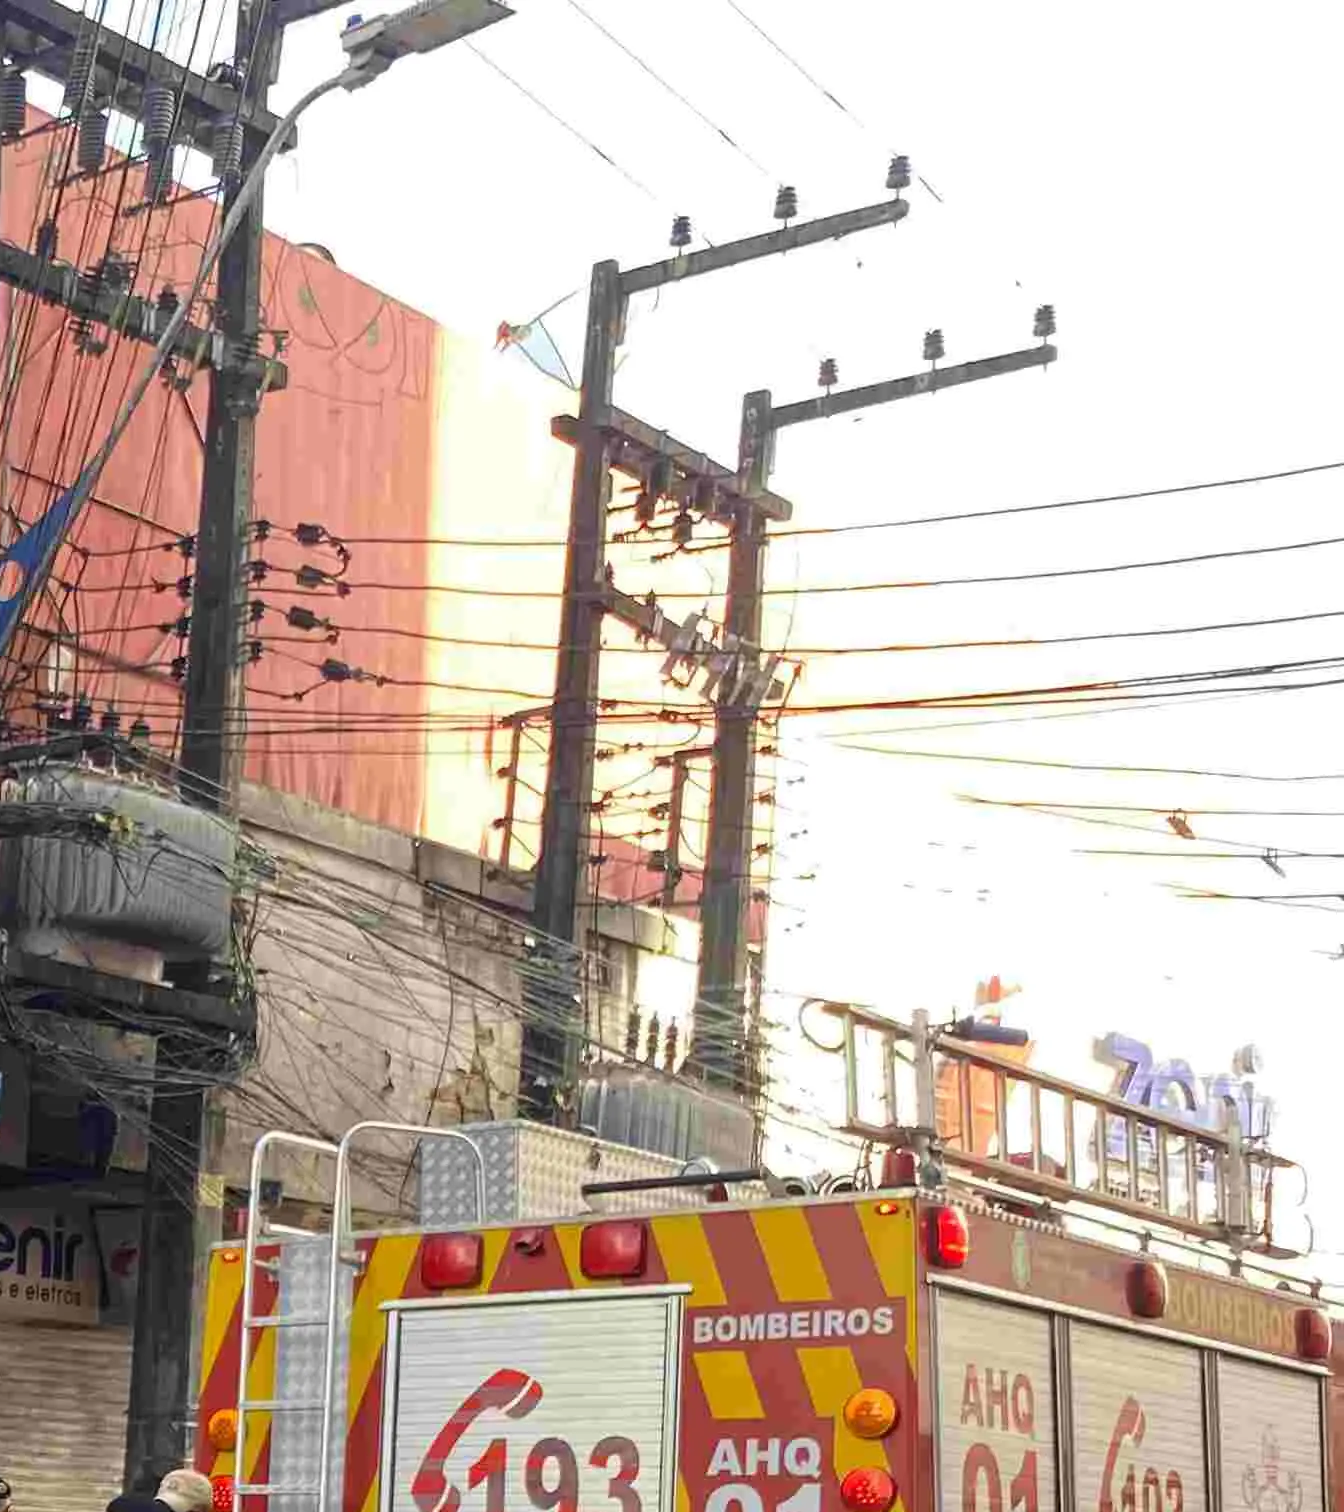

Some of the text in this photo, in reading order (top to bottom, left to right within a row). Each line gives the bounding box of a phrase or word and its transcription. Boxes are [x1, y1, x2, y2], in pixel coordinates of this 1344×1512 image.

[693, 1306, 894, 1344] BOMBEIROS
[960, 1362, 1037, 1438] AHQ
[705, 1436, 822, 1479] AHQ
